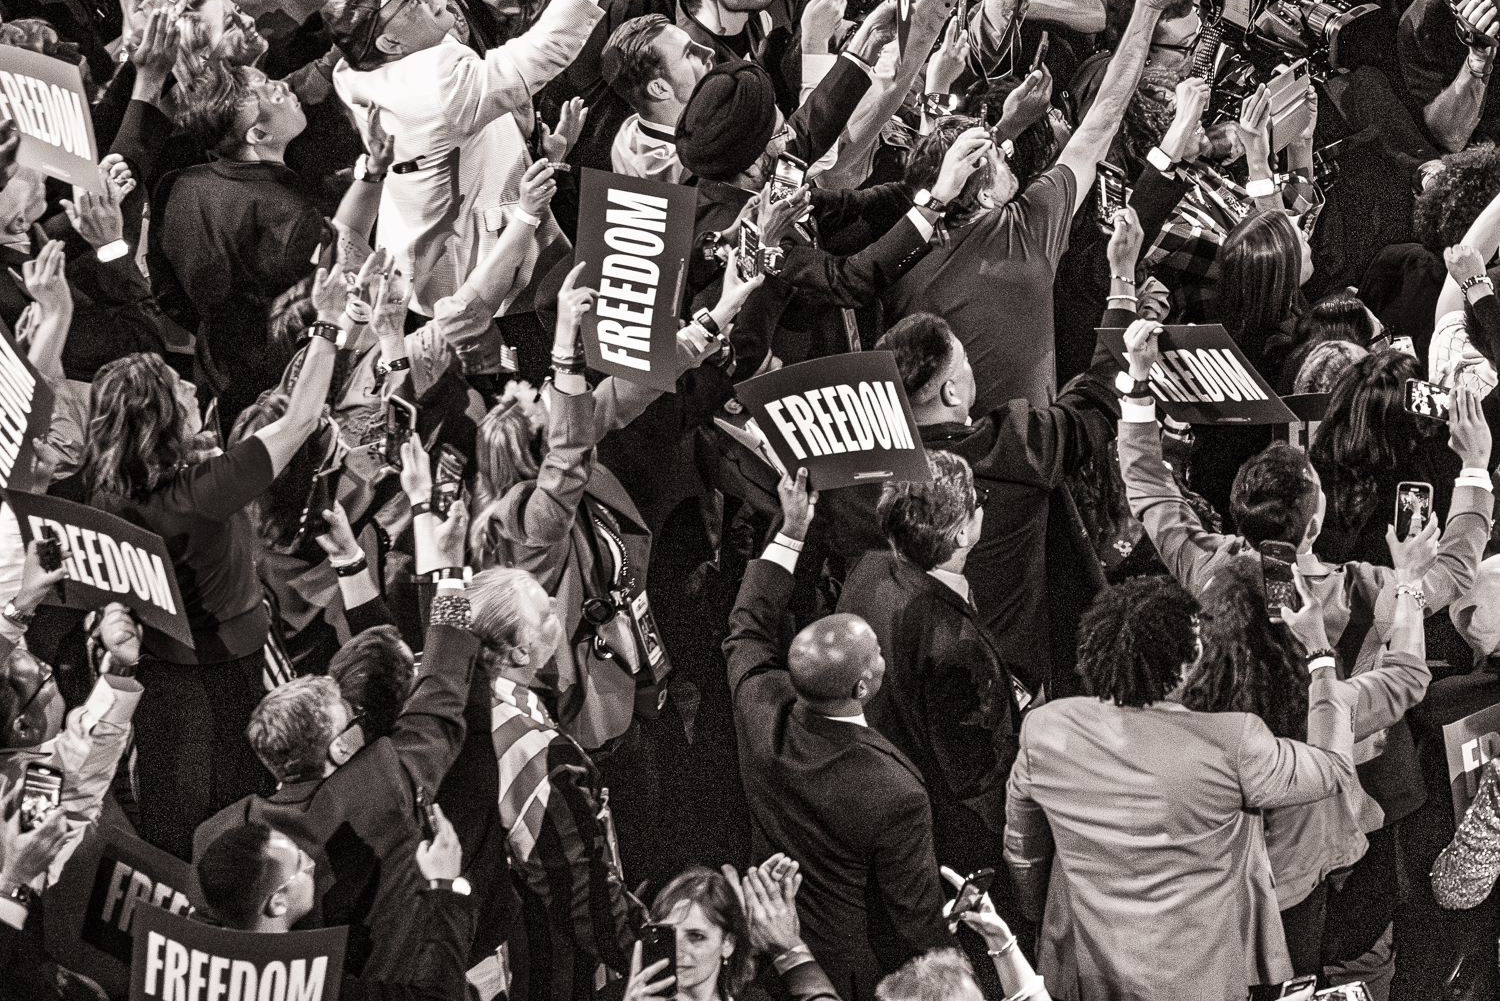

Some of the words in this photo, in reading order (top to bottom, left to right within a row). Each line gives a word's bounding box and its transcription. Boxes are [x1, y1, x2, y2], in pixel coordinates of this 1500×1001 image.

[597, 188, 668, 371] FREEDOM
[764, 381, 915, 460] FREEDOM
[144, 931, 328, 1001] FREEDOM
